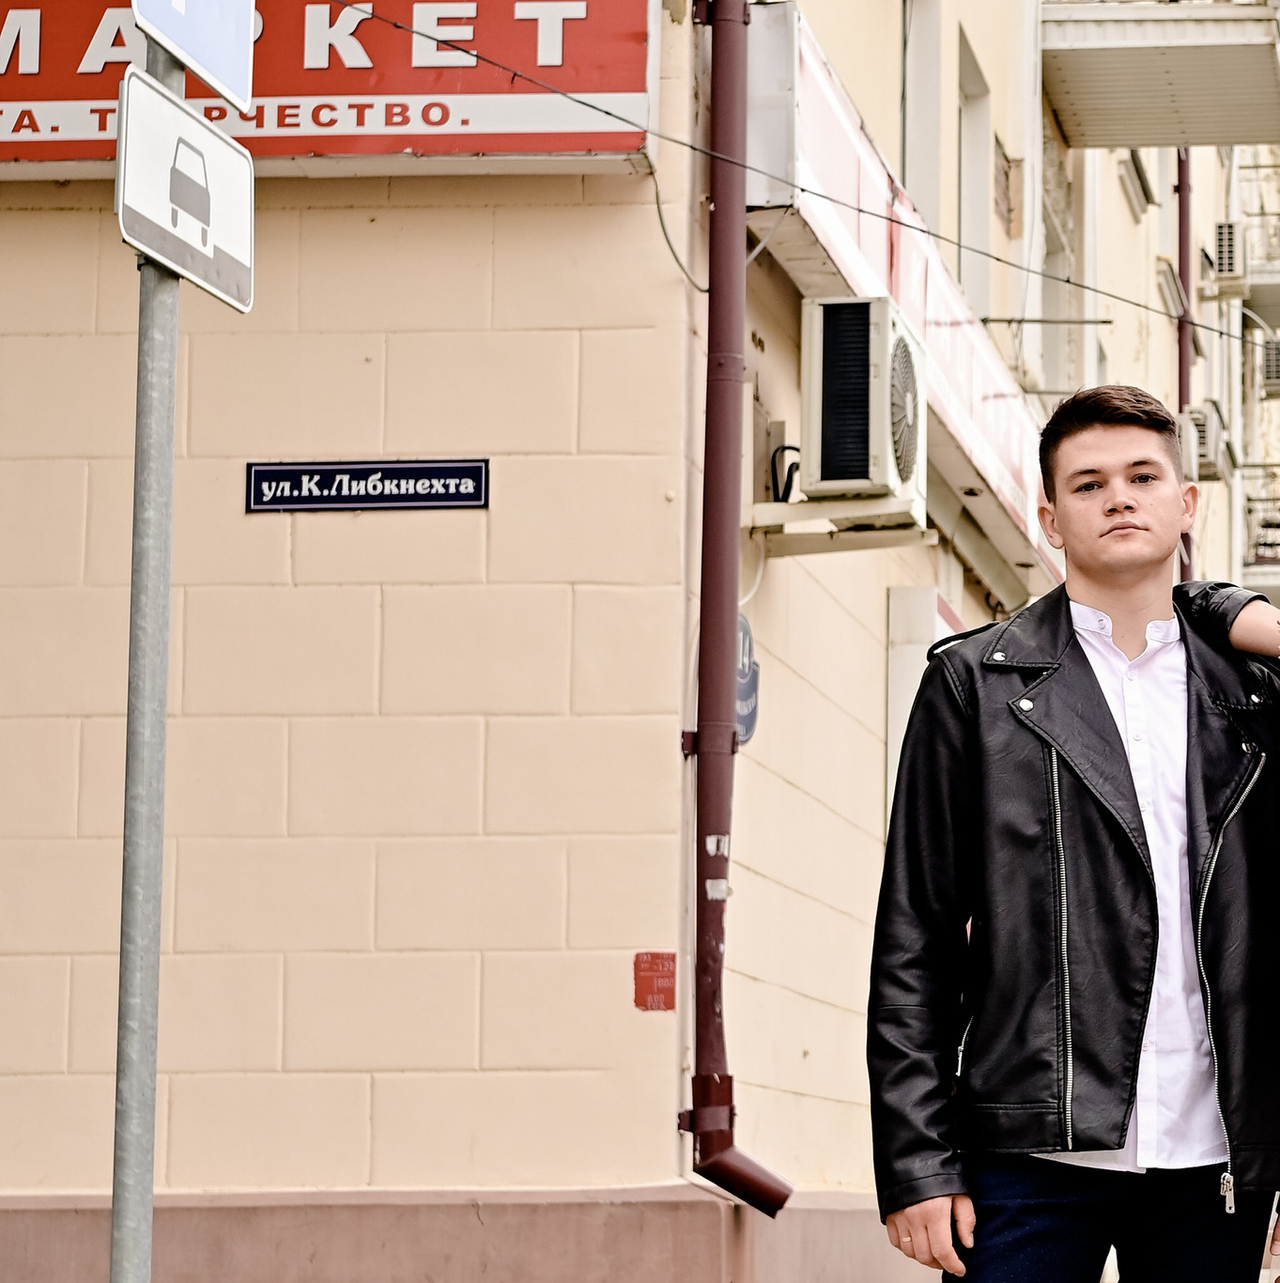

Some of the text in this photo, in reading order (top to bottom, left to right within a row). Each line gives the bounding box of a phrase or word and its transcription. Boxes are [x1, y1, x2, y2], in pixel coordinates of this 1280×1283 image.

[0, 1, 588, 75] МАКЕТ
[0, 101, 471, 133] А. ТРЧЕСТВО.
[261, 471, 476, 502] ул.К.Либкнехта
